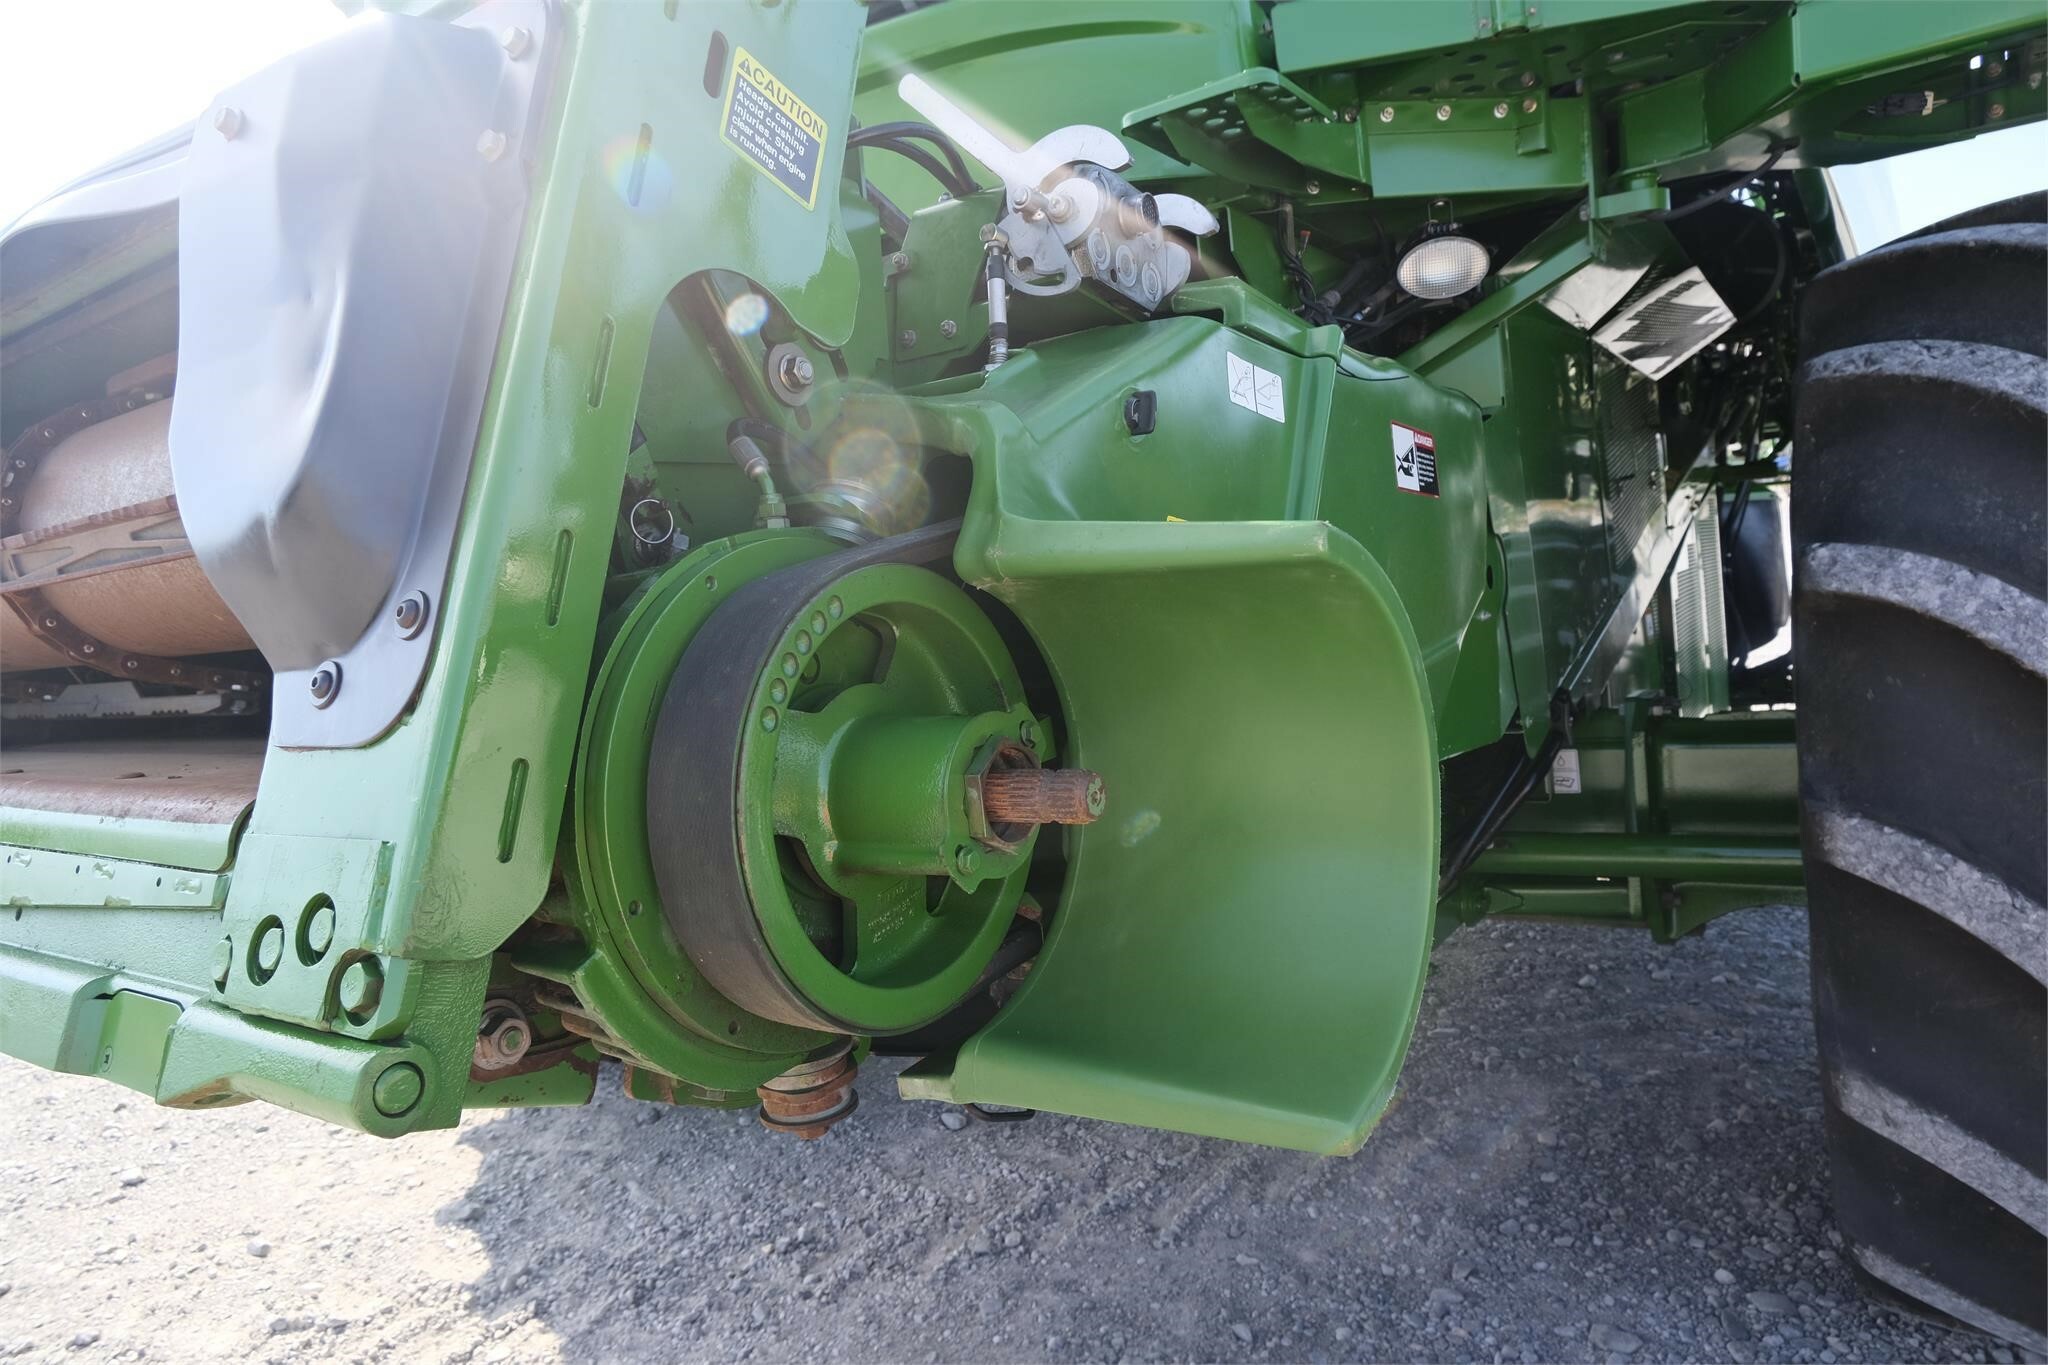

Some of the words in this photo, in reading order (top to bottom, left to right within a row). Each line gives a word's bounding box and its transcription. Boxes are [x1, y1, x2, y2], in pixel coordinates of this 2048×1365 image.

[734, 103, 772, 141] injuries.
[774, 138, 796, 160] Stay
[736, 92, 764, 119] Avoid
[765, 115, 805, 156] crushing
[739, 79, 773, 113] Header
[775, 113, 792, 131] can
[794, 126, 809, 146] tilt.
[753, 68, 823, 138] CAUTION
[729, 126, 739, 138] is
[739, 135, 777, 170] running.
[731, 116, 754, 136] clear
[755, 133, 778, 157] when
[778, 152, 807, 181] engine
